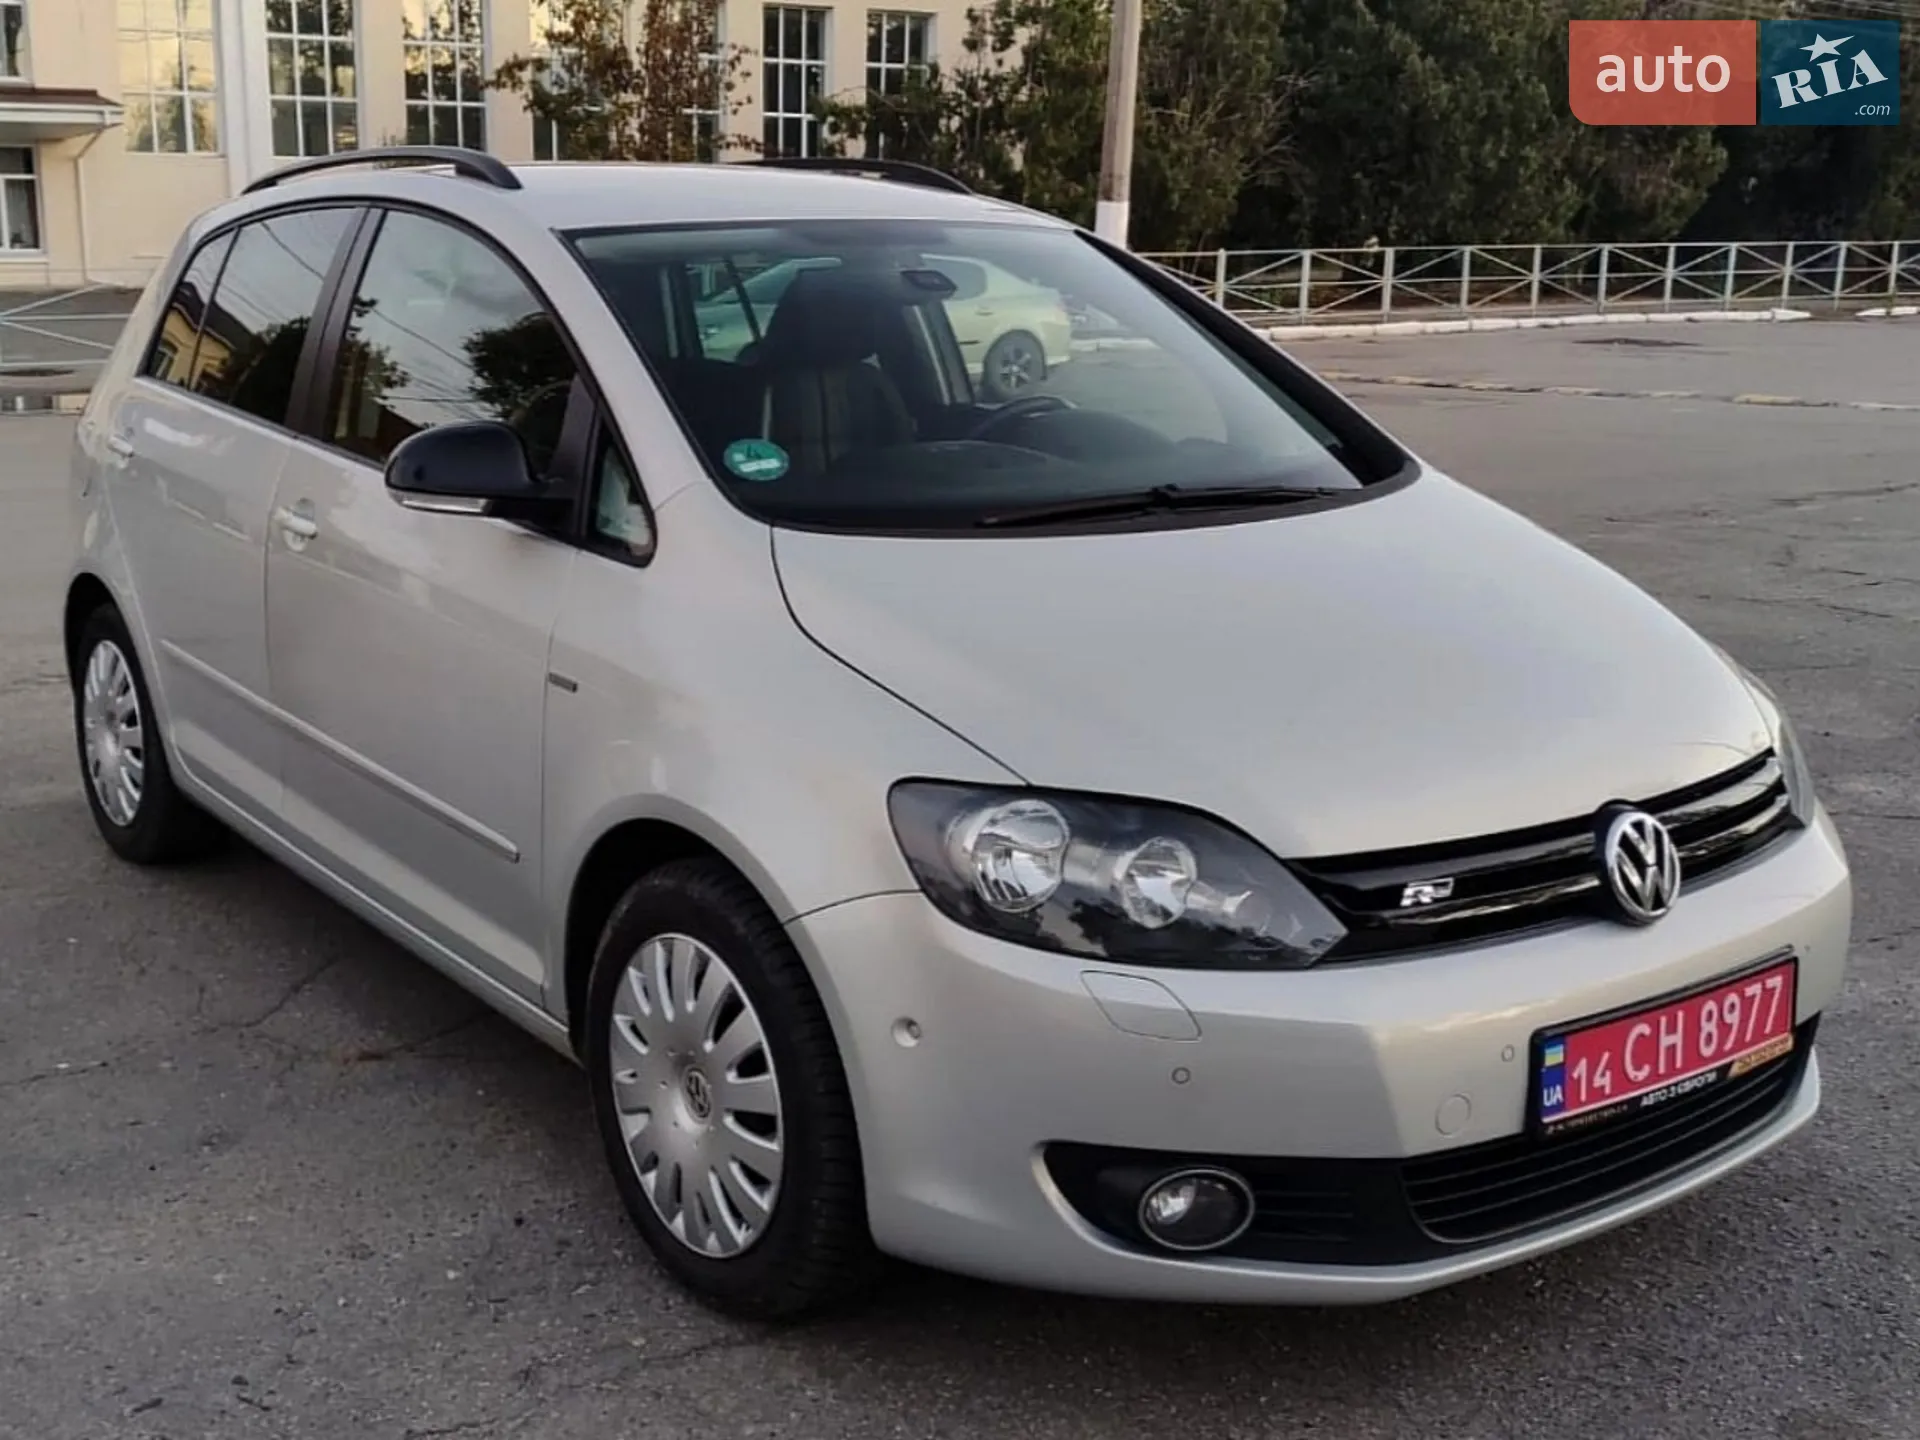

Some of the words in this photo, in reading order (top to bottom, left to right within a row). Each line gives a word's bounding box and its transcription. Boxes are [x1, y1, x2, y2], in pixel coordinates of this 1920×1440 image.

[1571, 1050, 1612, 1102] 14
[1624, 1010, 1684, 1083] CH
[1699, 974, 1783, 1058] 8977
[1543, 1086, 1564, 1107] UA
